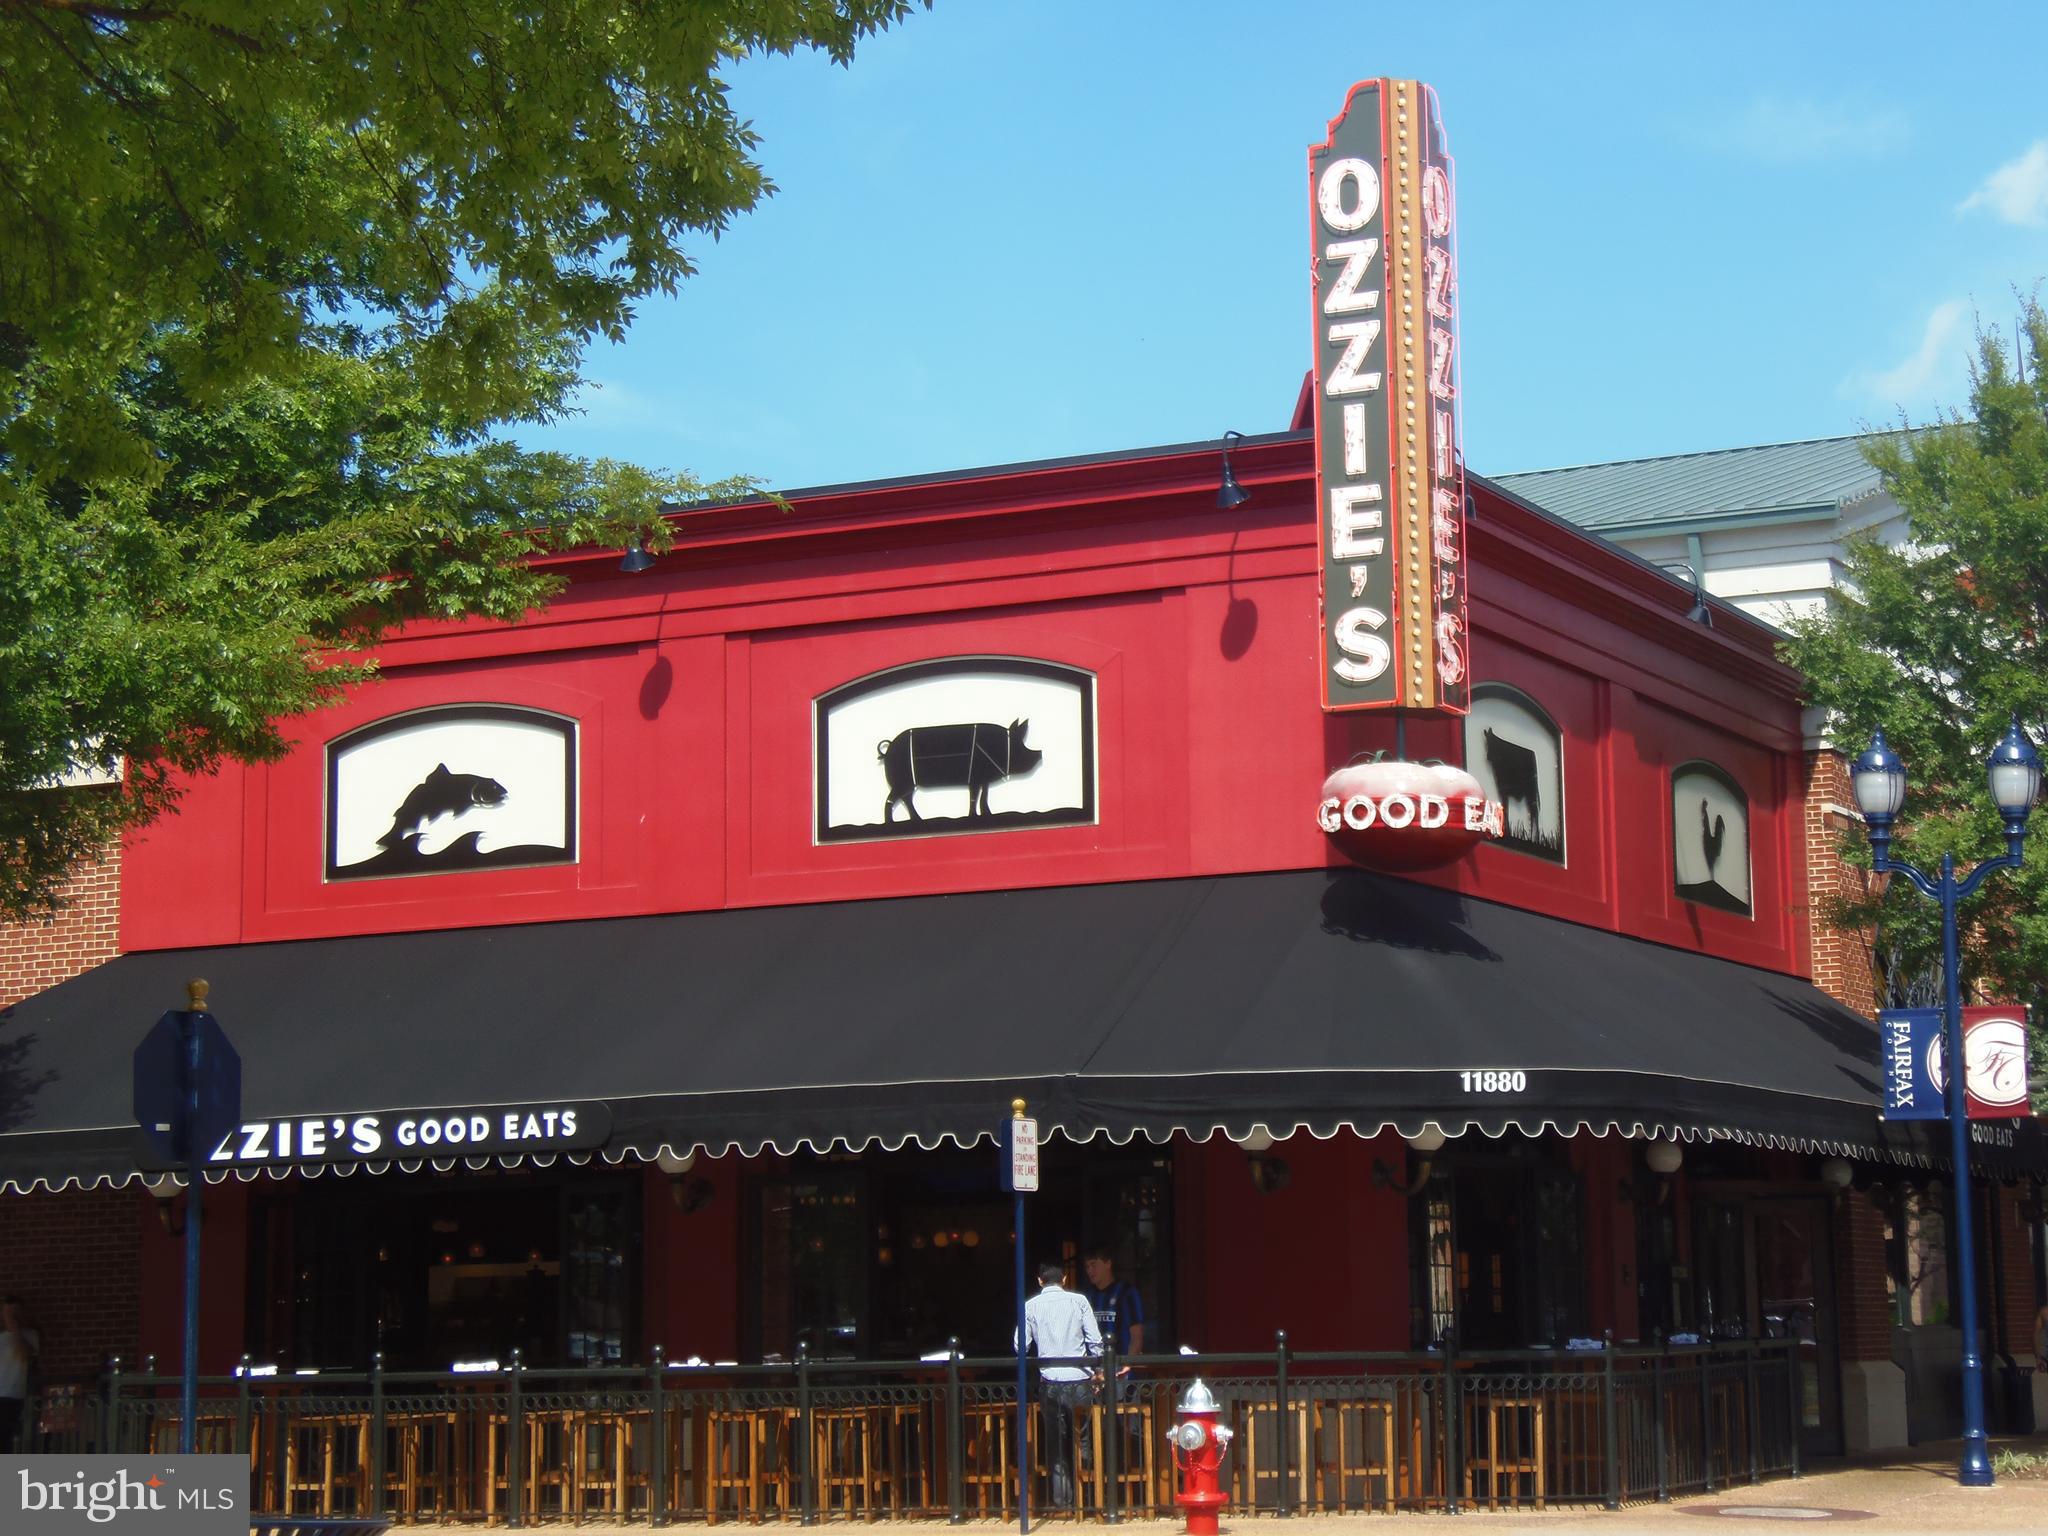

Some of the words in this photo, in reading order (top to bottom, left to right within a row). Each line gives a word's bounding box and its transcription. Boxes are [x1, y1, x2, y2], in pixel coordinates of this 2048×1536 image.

[1318, 157, 1391, 683] OZZIE'S
[1317, 794, 1449, 833] GOOD
[1464, 797, 1504, 838] EA
[1460, 1071, 1526, 1093] 11880
[1886, 1022, 1896, 1108] CORNER
[1893, 1022, 1914, 1108] FAIRFAX
[397, 1118, 490, 1147] GOOD
[504, 1111, 577, 1141] EATS
[1016, 1136, 1034, 1146] PARKING
[1972, 1123, 1994, 1146] GOOD
[1996, 1128, 2013, 1148] EATS
